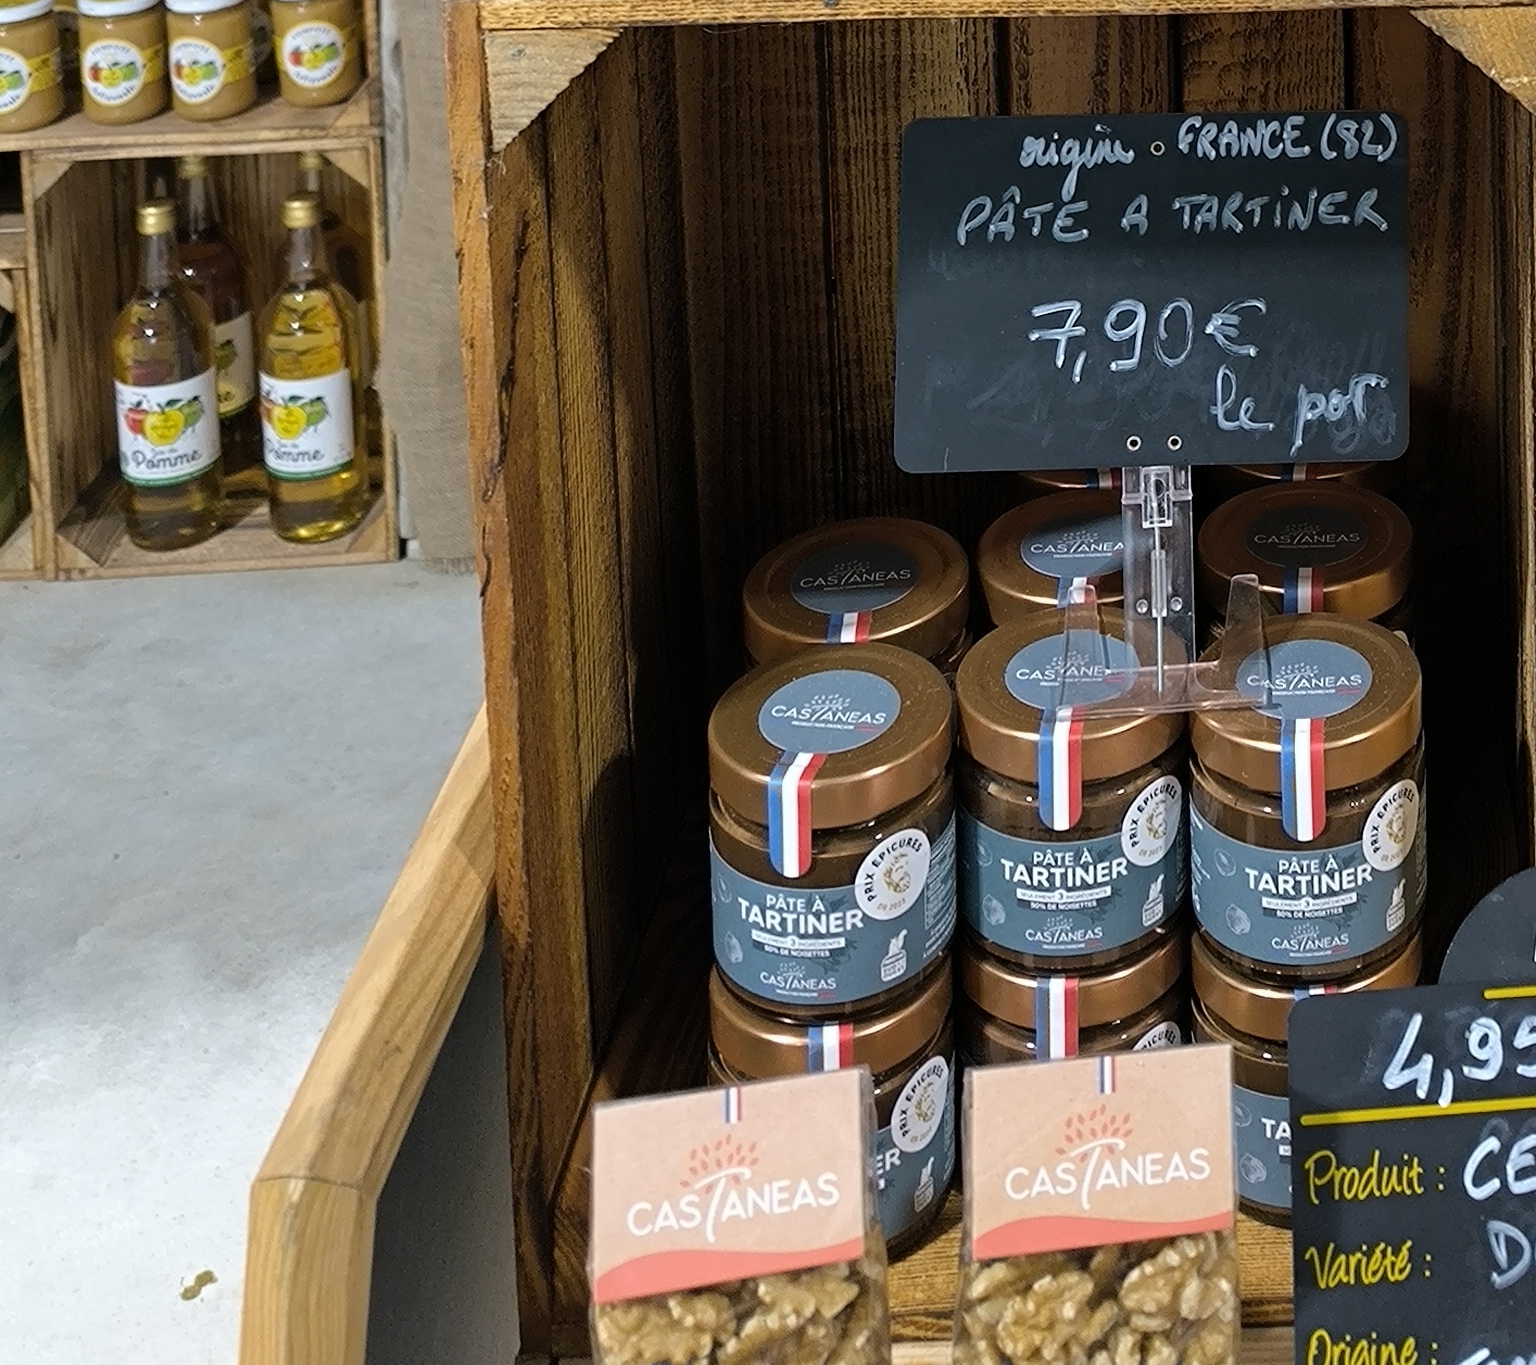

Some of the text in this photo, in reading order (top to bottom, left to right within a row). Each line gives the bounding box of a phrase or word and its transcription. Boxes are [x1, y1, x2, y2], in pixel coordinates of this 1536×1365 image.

[1177, 114, 1312, 161] FRANCE
[957, 185, 1091, 246] PÂTE
[1121, 193, 1149, 235] A
[1210, 364, 1275, 431] le
[131, 449, 202, 470] Pomme
[771, 705, 887, 725] CASTANEAS
[864, 837, 924, 902] PRIX EPICURES
[1000, 857, 1129, 888] TARTINER
[1033, 847, 1093, 867] PÂTE À
[1244, 864, 1374, 897] TARTINER
[738, 897, 864, 934] TARTINER
[766, 893, 826, 912] PÂTE À
[760, 969, 836, 990] CASTANEAS
[1004, 1138, 1210, 1210] CASTANEAS
[1304, 1150, 1425, 1204] Produit
[626, 1167, 840, 1243] CASTANEAS
[1305, 1239, 1412, 1289] Variété
